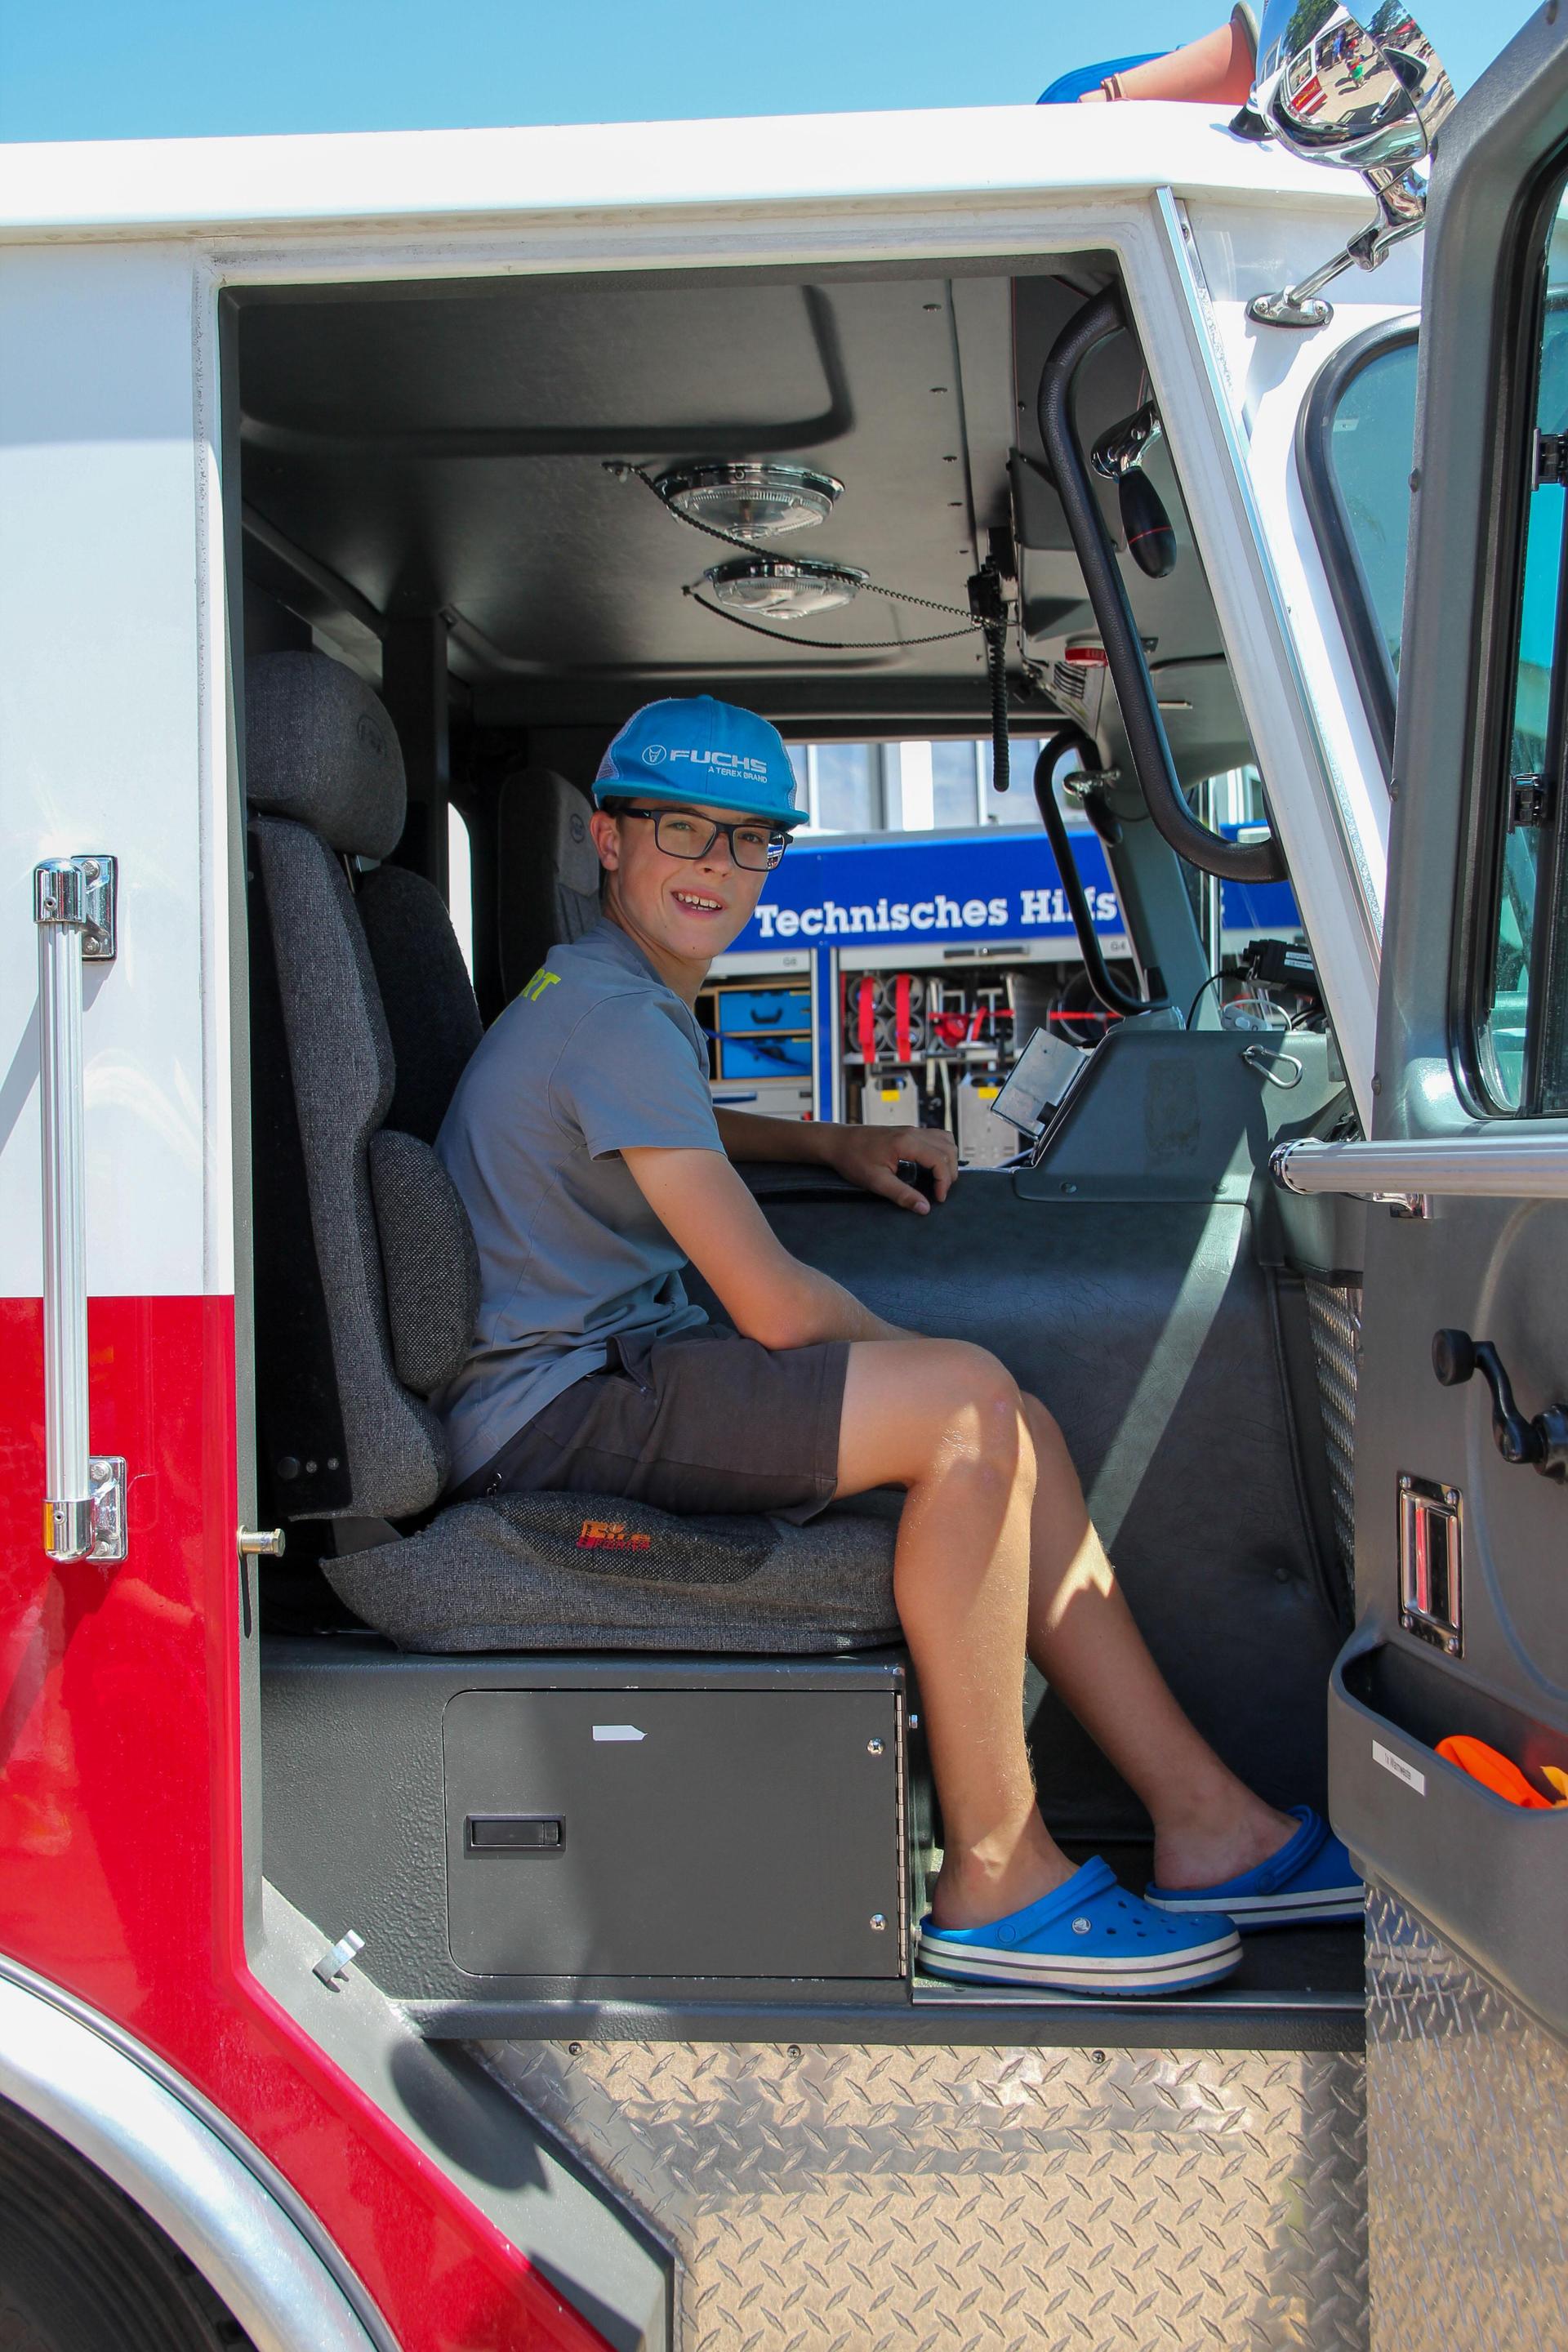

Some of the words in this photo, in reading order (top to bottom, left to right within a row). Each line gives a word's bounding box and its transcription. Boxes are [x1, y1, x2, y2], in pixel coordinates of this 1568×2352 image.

[669, 749, 767, 774] FUCHS
[716, 767, 742, 778] TEREX
[743, 772, 768, 784] BRAND
[754, 895, 1009, 938] Technisches
